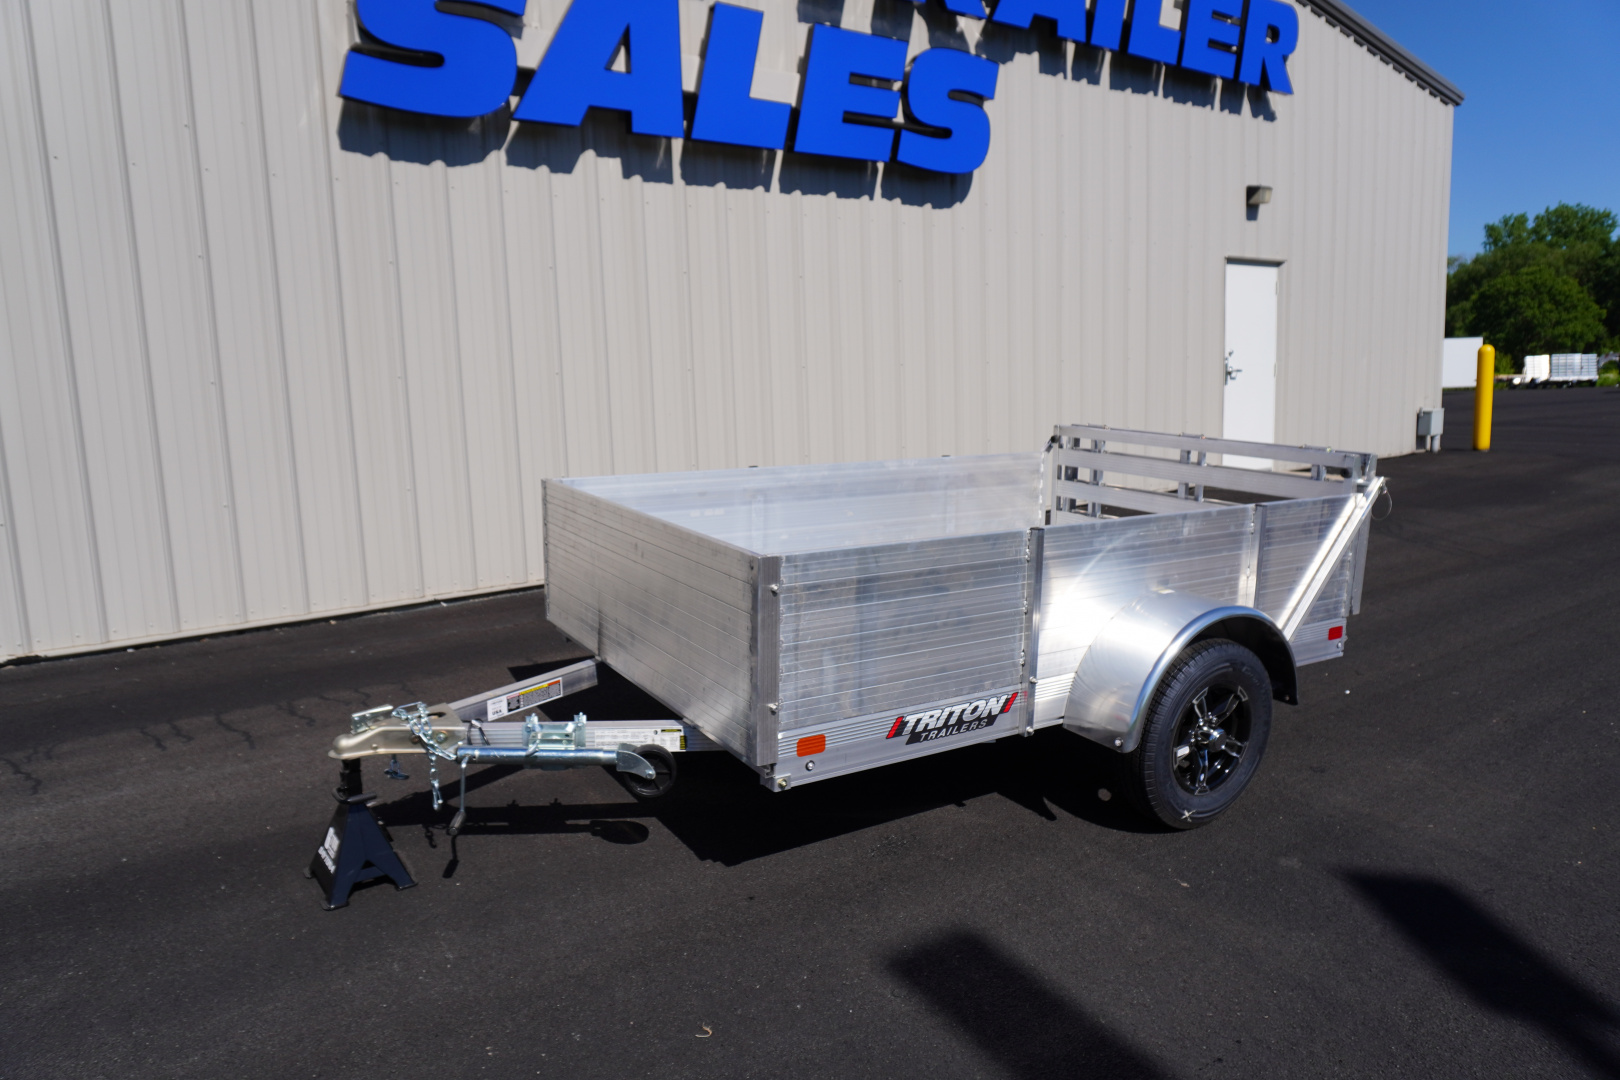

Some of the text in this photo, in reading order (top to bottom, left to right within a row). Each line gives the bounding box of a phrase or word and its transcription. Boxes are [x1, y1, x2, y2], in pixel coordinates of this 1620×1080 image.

[341, 0, 999, 174] SALES
[902, 694, 1009, 736] TRITON
[919, 718, 988, 742] TRAILERS
